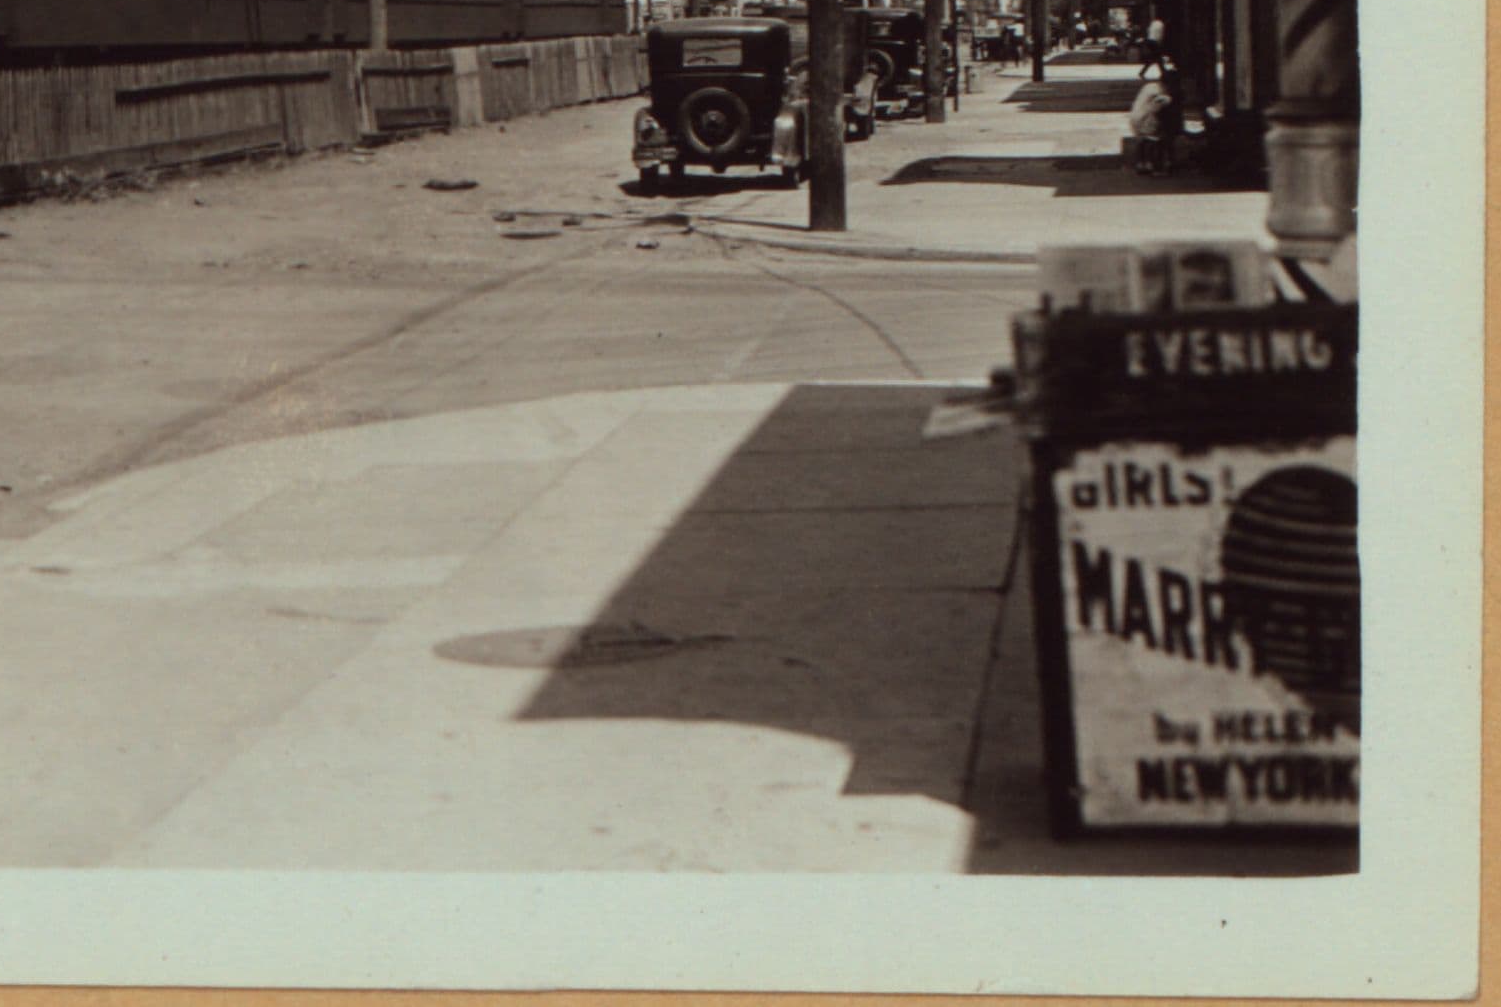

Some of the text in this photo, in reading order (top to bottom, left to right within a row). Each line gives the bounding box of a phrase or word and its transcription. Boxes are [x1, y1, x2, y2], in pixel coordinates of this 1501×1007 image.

[1125, 329, 1333, 377] EVENING
[1071, 538, 1264, 675] MARR
[1136, 755, 1360, 804] NEW YORK
